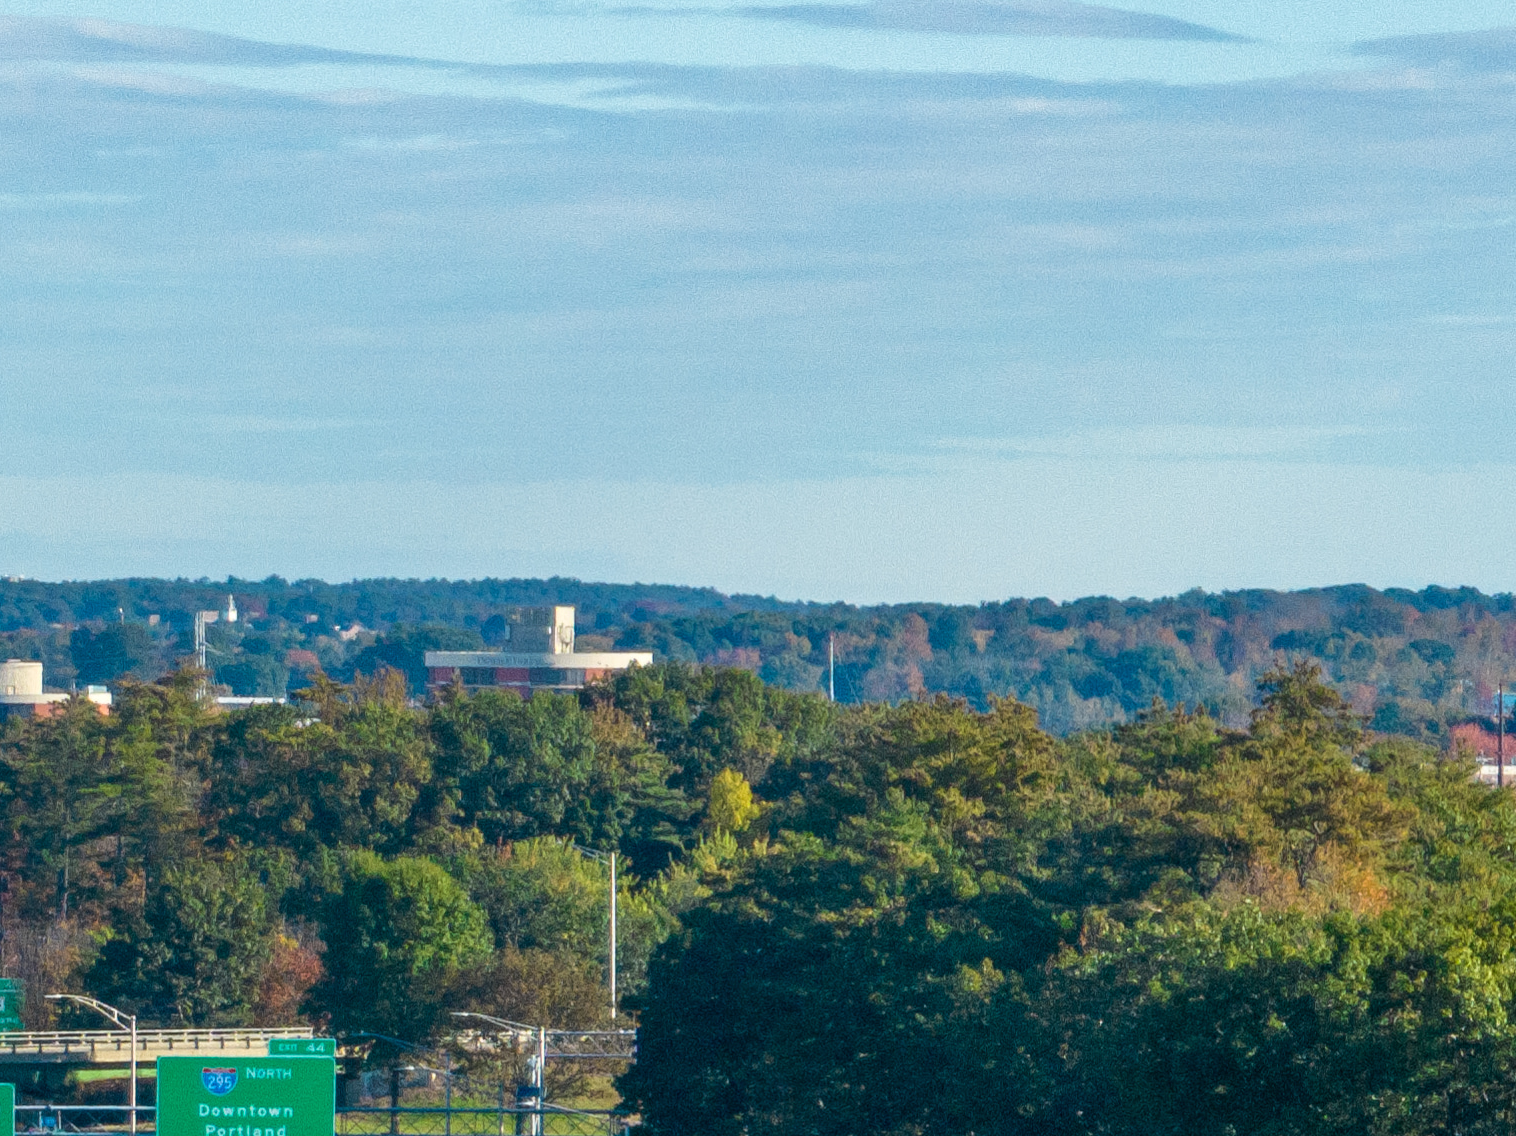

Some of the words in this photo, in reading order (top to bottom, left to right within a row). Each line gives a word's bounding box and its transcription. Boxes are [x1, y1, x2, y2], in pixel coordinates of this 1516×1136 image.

[278, 1043, 297, 1051] EXIT
[306, 1042, 326, 1052] 44
[246, 1067, 292, 1080] NORTH
[208, 1076, 232, 1090] 295
[199, 1104, 294, 1117] Downtown
